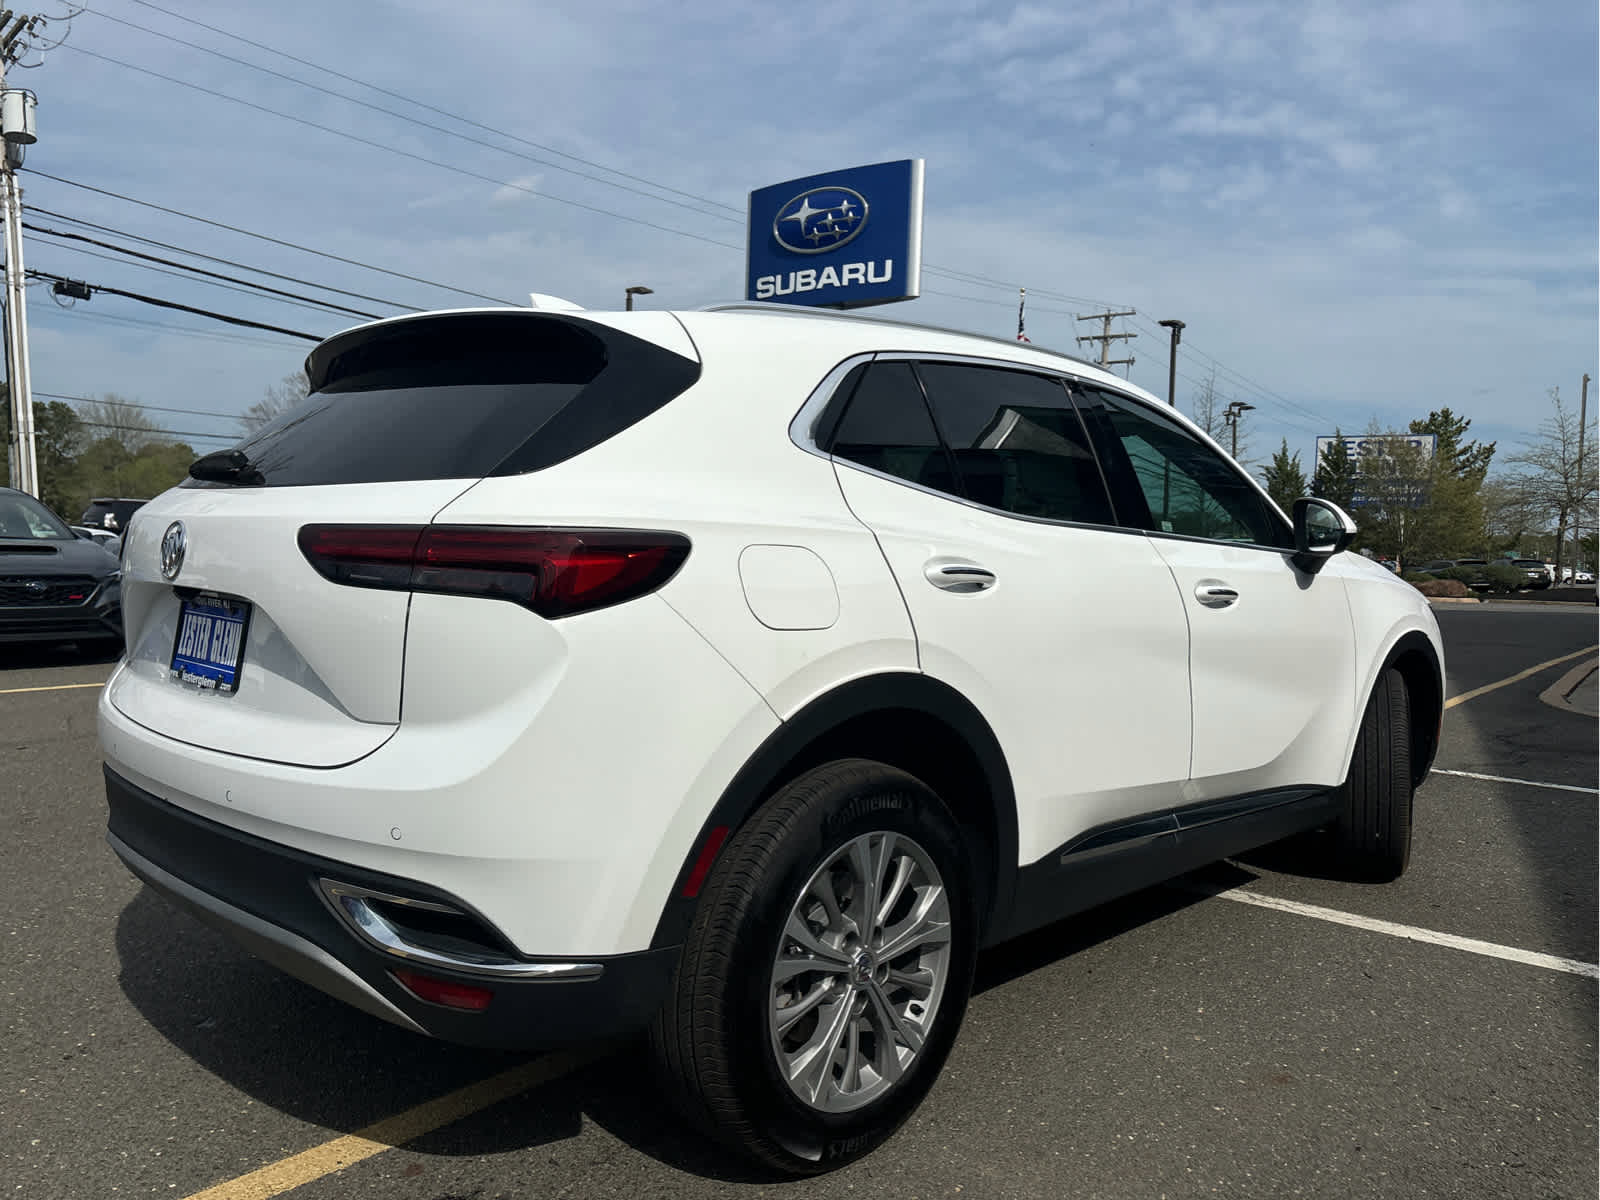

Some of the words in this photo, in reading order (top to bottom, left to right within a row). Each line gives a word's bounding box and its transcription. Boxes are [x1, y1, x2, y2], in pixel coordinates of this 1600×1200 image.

[756, 259, 893, 299] SUBARU
[177, 613, 212, 660] LESTER
[210, 619, 243, 667] GLENN
